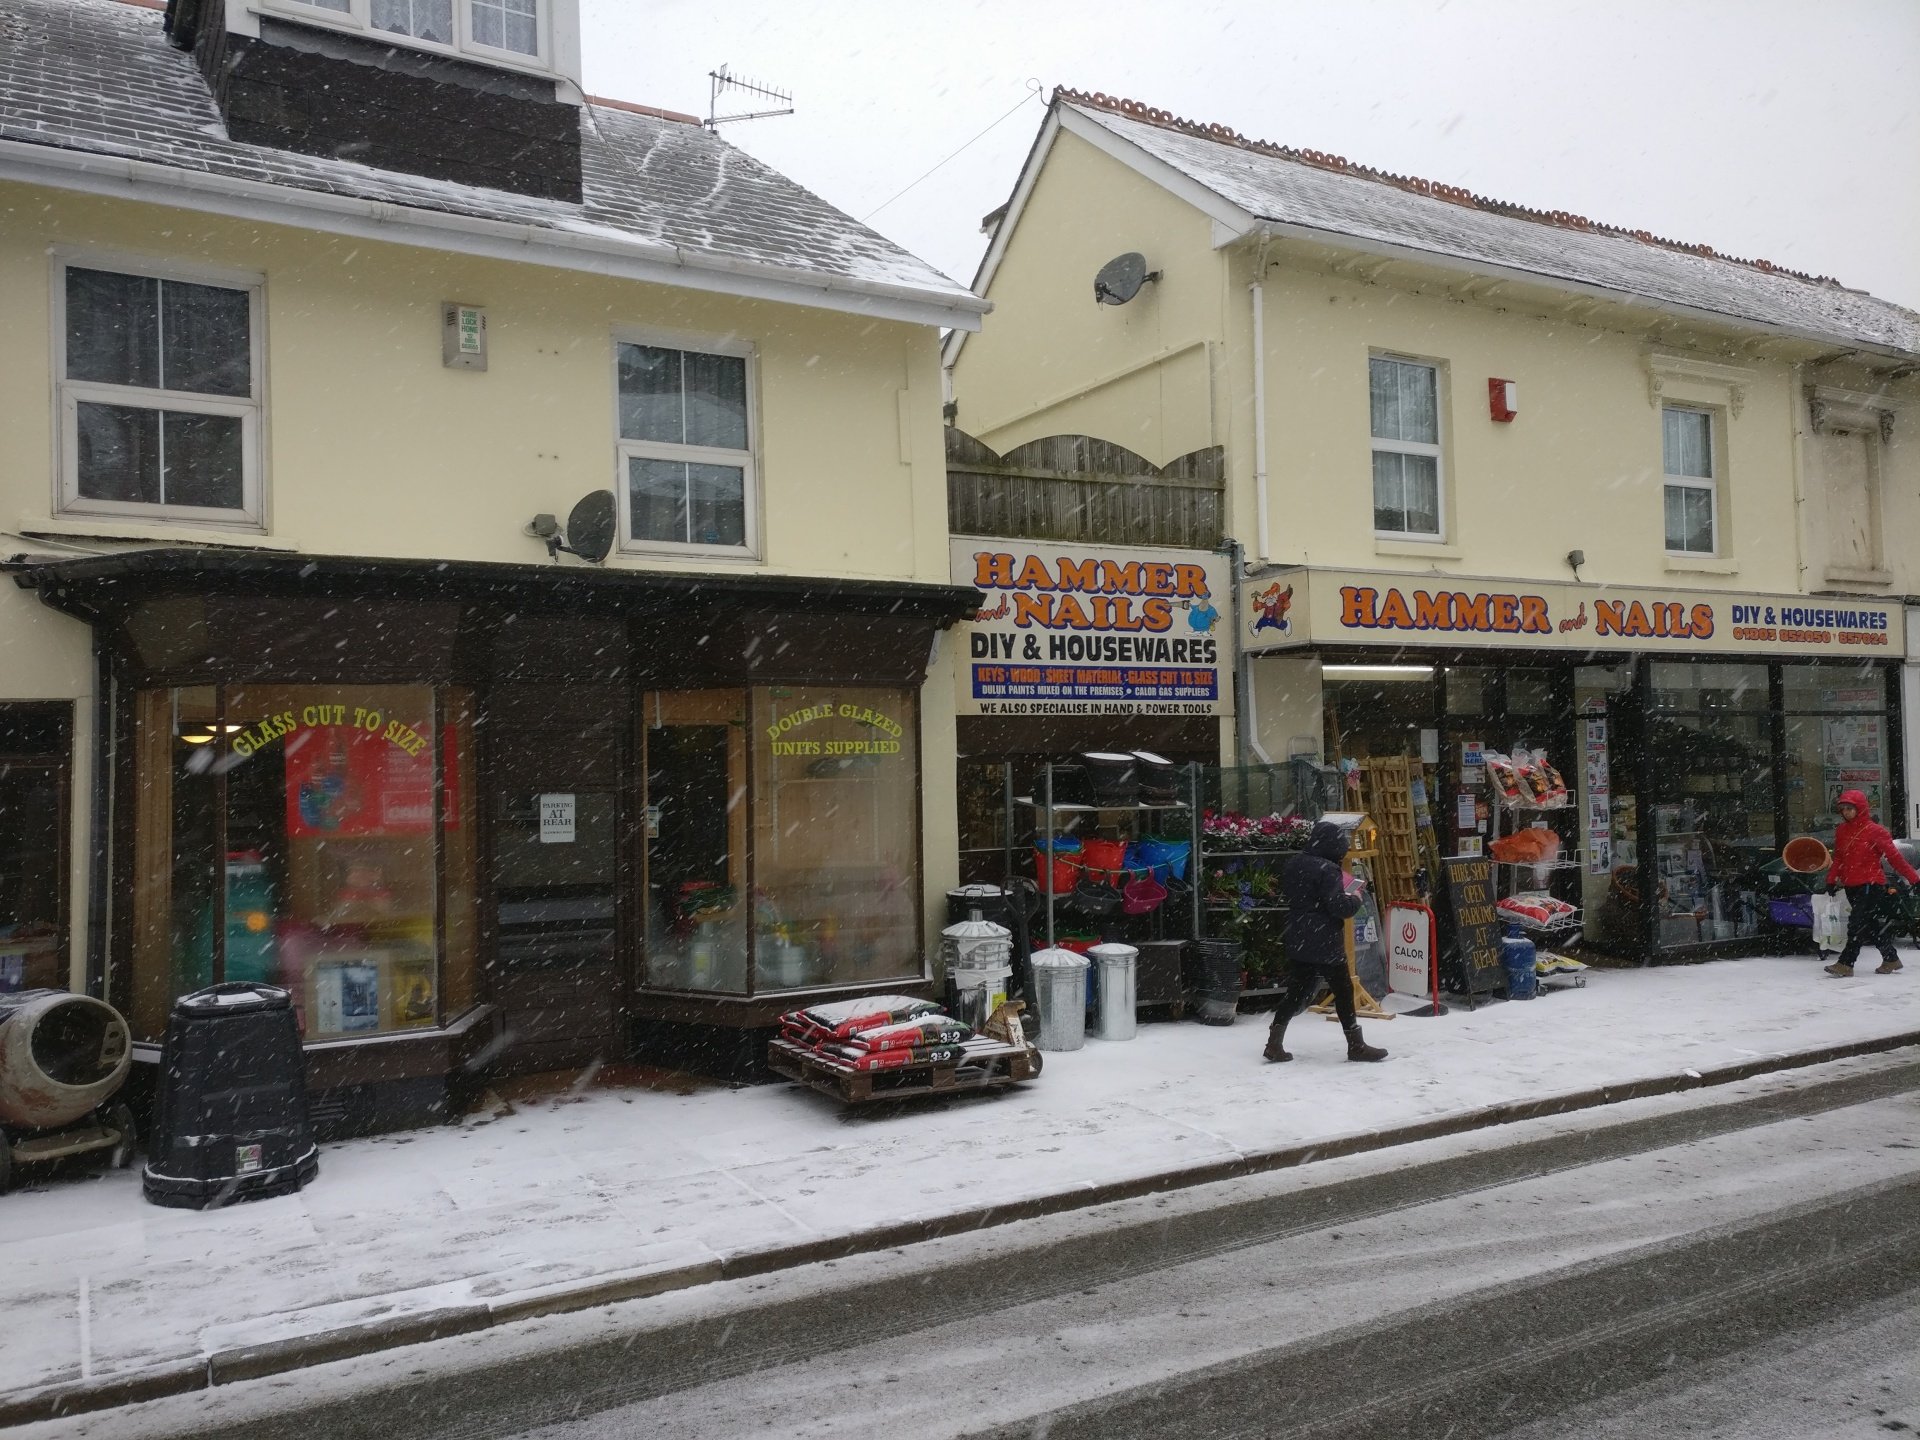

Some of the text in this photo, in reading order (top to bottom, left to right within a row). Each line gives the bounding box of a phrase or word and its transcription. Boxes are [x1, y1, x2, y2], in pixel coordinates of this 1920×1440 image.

[973, 552, 1212, 599] HAMMER
[974, 592, 1174, 632] and NAILS
[1340, 586, 1715, 639] HAMMER and NAILS
[1732, 605, 1888, 630] DIY & HOUSEWARES
[971, 632, 1217, 664] DIY & HOUSEWARES
[978, 667, 1213, 685] KEYS WOOD SHEET MATERIAL GLASS CUT TO SIZE
[982, 685, 1210, 698] DULUX PAINTS MIXED ON THE PREMISES CALOR GAS SUPPLIERS
[980, 703, 1212, 714] WE ALSO SPECIALISE IN HAND & POWER TOOLS
[232, 705, 427, 757] GLASS CUT TO SIZE
[767, 704, 902, 740] DOUBLE GLAZED
[771, 741, 901, 755] UNITS SUPPLIED
[543, 818, 572, 826] REAR
[549, 809, 566, 818] AT
[1449, 862, 1490, 883] HIRE SHOP
[1463, 884, 1486, 904] OPEN
[1458, 905, 1496, 927] PARKING
[1475, 927, 1488, 946] AT
[1394, 945, 1424, 960] CALOR
[1472, 947, 1499, 969] REAR
[1395, 962, 1422, 975] Sold Here
[940, 1032, 949, 1043] 3
[952, 1031, 961, 1043] 2
[930, 1052, 938, 1062] 3
[943, 1051, 951, 1060] 2
